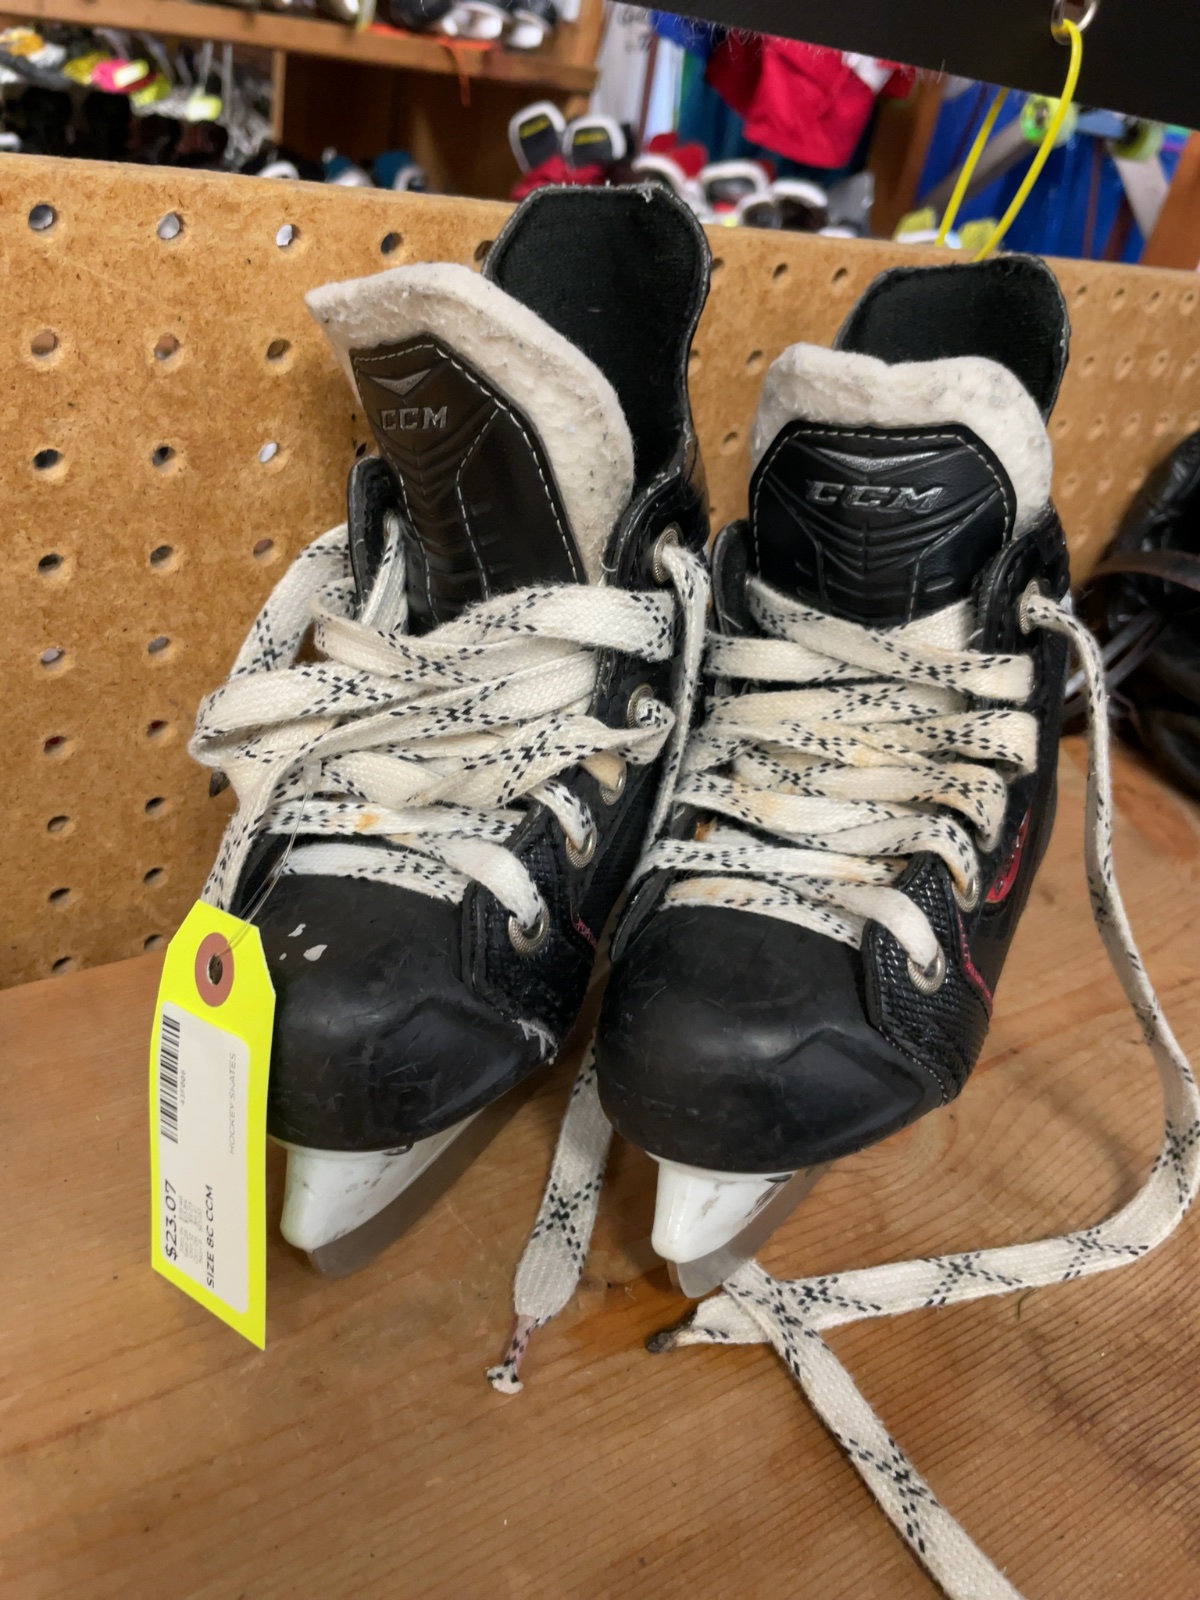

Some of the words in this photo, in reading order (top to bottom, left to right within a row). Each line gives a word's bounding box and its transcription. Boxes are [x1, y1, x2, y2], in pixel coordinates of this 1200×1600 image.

[381, 406, 448, 431] CCM
[807, 480, 943, 510] CCM
[229, 1053, 237, 1098] SKATES
[165, 1179, 178, 1261] $23.07
[205, 1184, 214, 1222] CCM
[206, 1225, 214, 1248] 8C
[206, 1251, 215, 1288] SIZE
